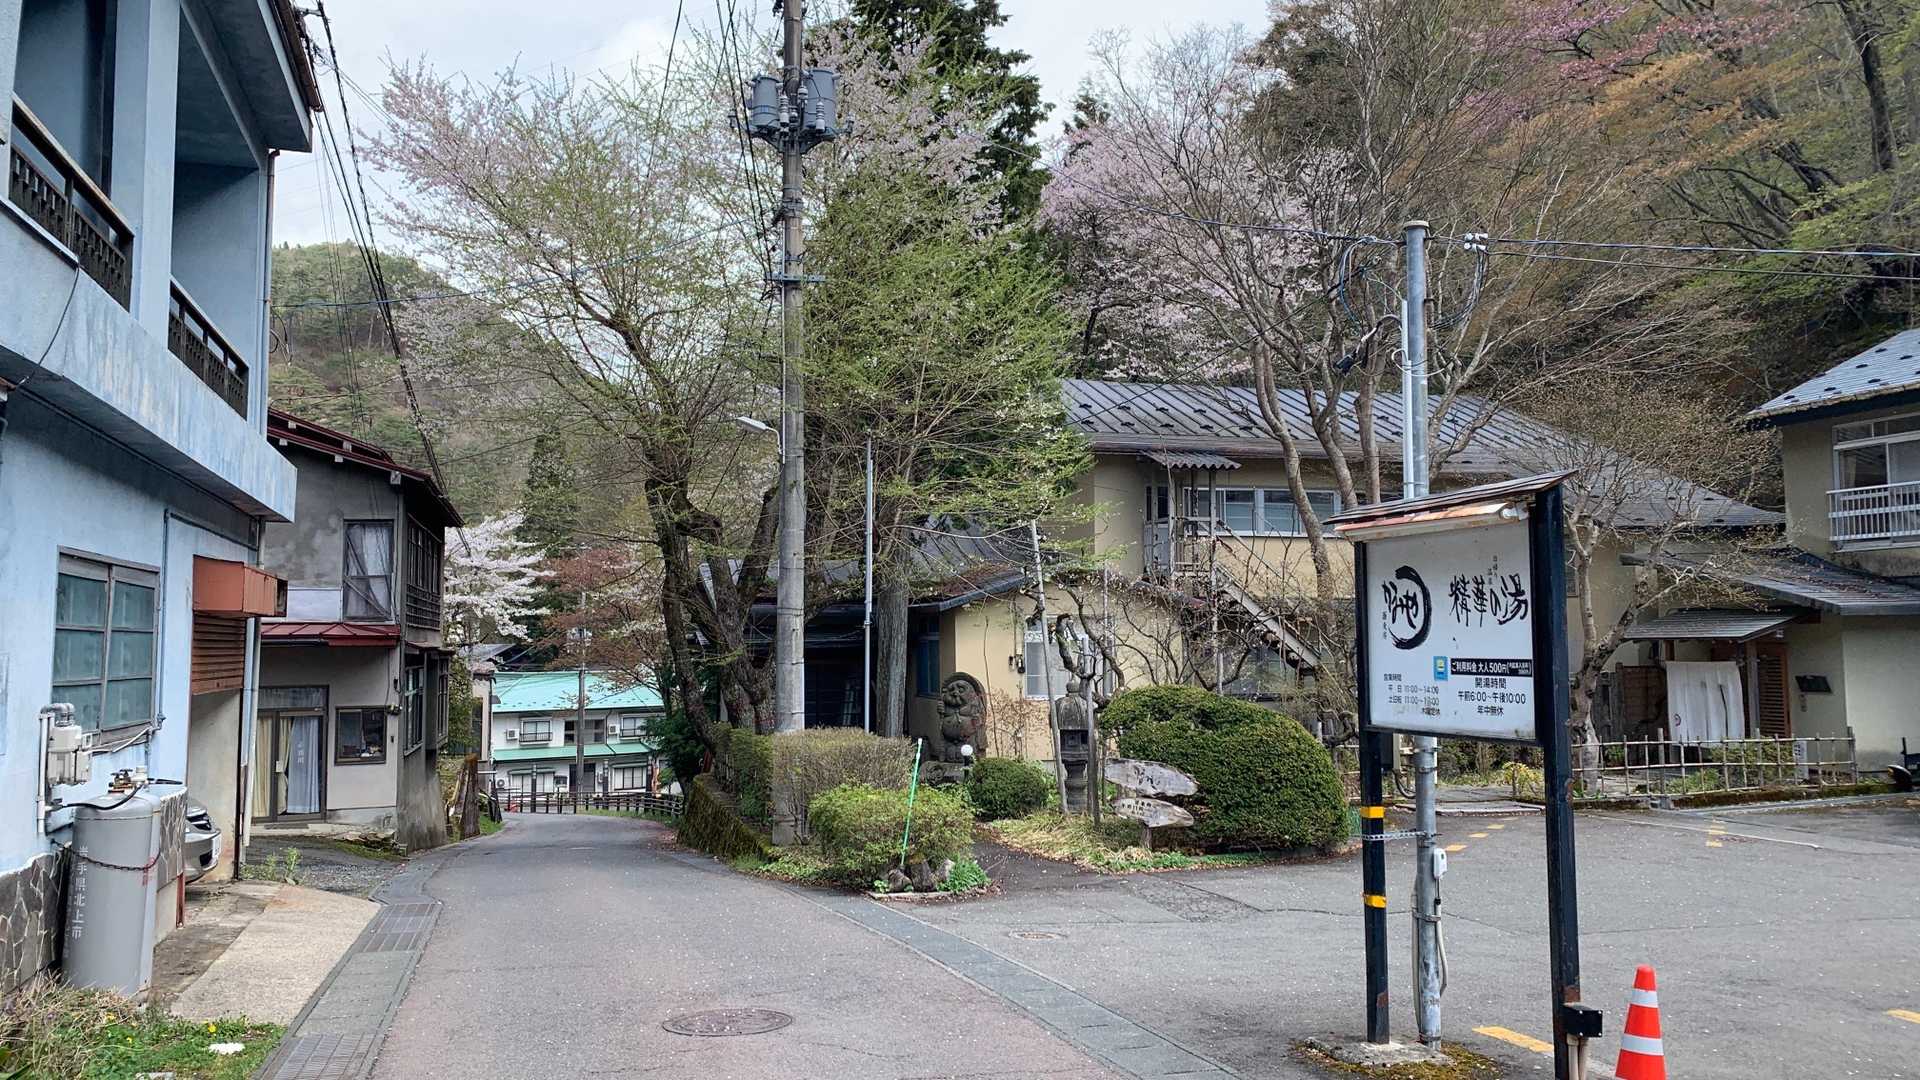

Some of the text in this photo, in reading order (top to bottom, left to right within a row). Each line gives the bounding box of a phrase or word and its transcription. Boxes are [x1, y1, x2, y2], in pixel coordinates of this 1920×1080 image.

[1475, 677, 1507, 689] 開湯時間
[1477, 705, 1504, 717] 年中無休
[72, 845, 88, 940] 岩手県北上市
